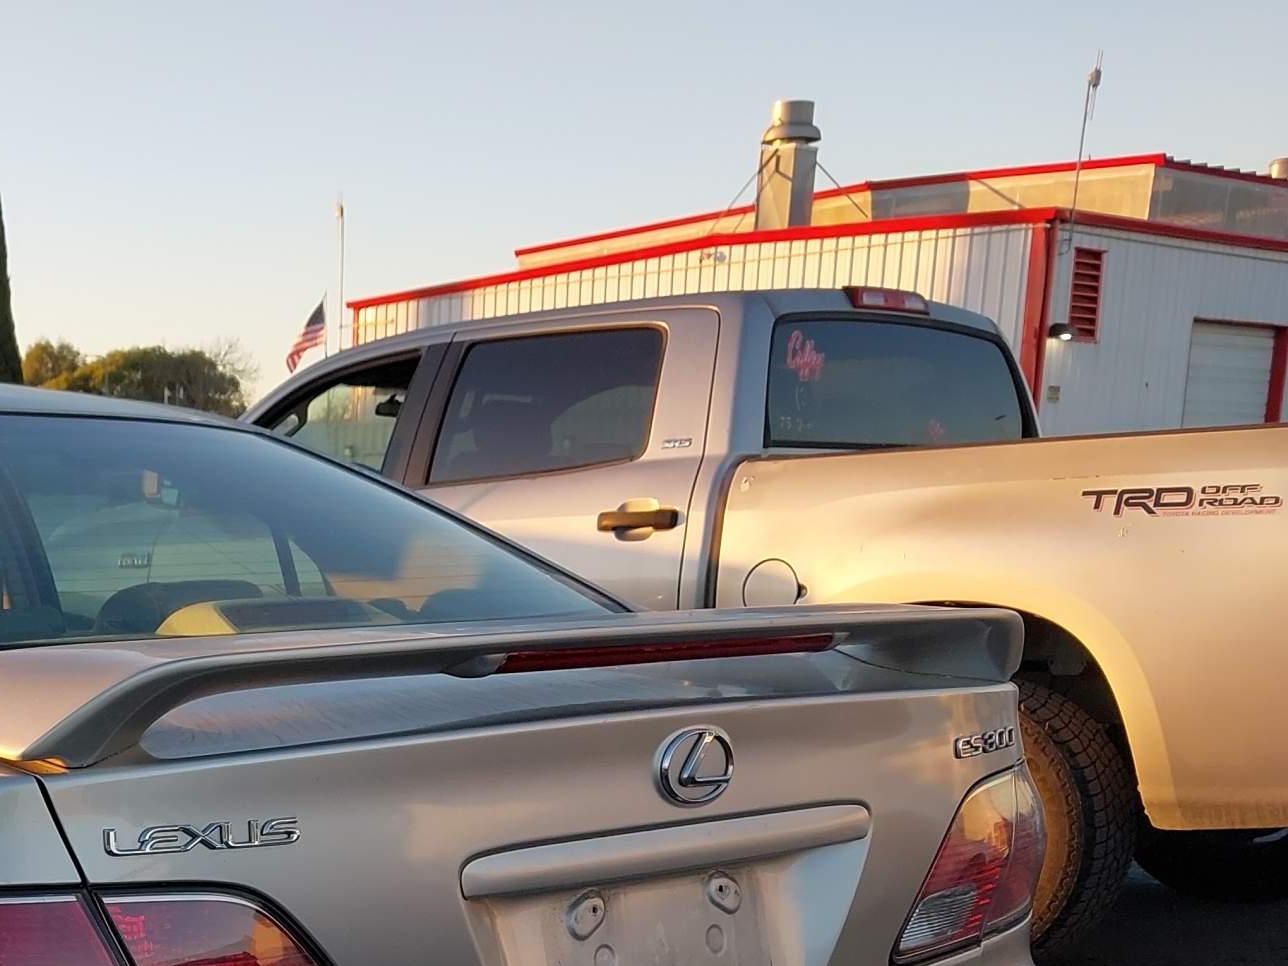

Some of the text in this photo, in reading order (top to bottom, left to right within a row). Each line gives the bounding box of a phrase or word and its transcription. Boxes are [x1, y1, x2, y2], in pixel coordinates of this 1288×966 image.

[1200, 483, 1263, 496] OFF
[1081, 486, 1195, 516] TRD
[1198, 496, 1282, 508] ROAD
[103, 816, 301, 857] LEXUS
